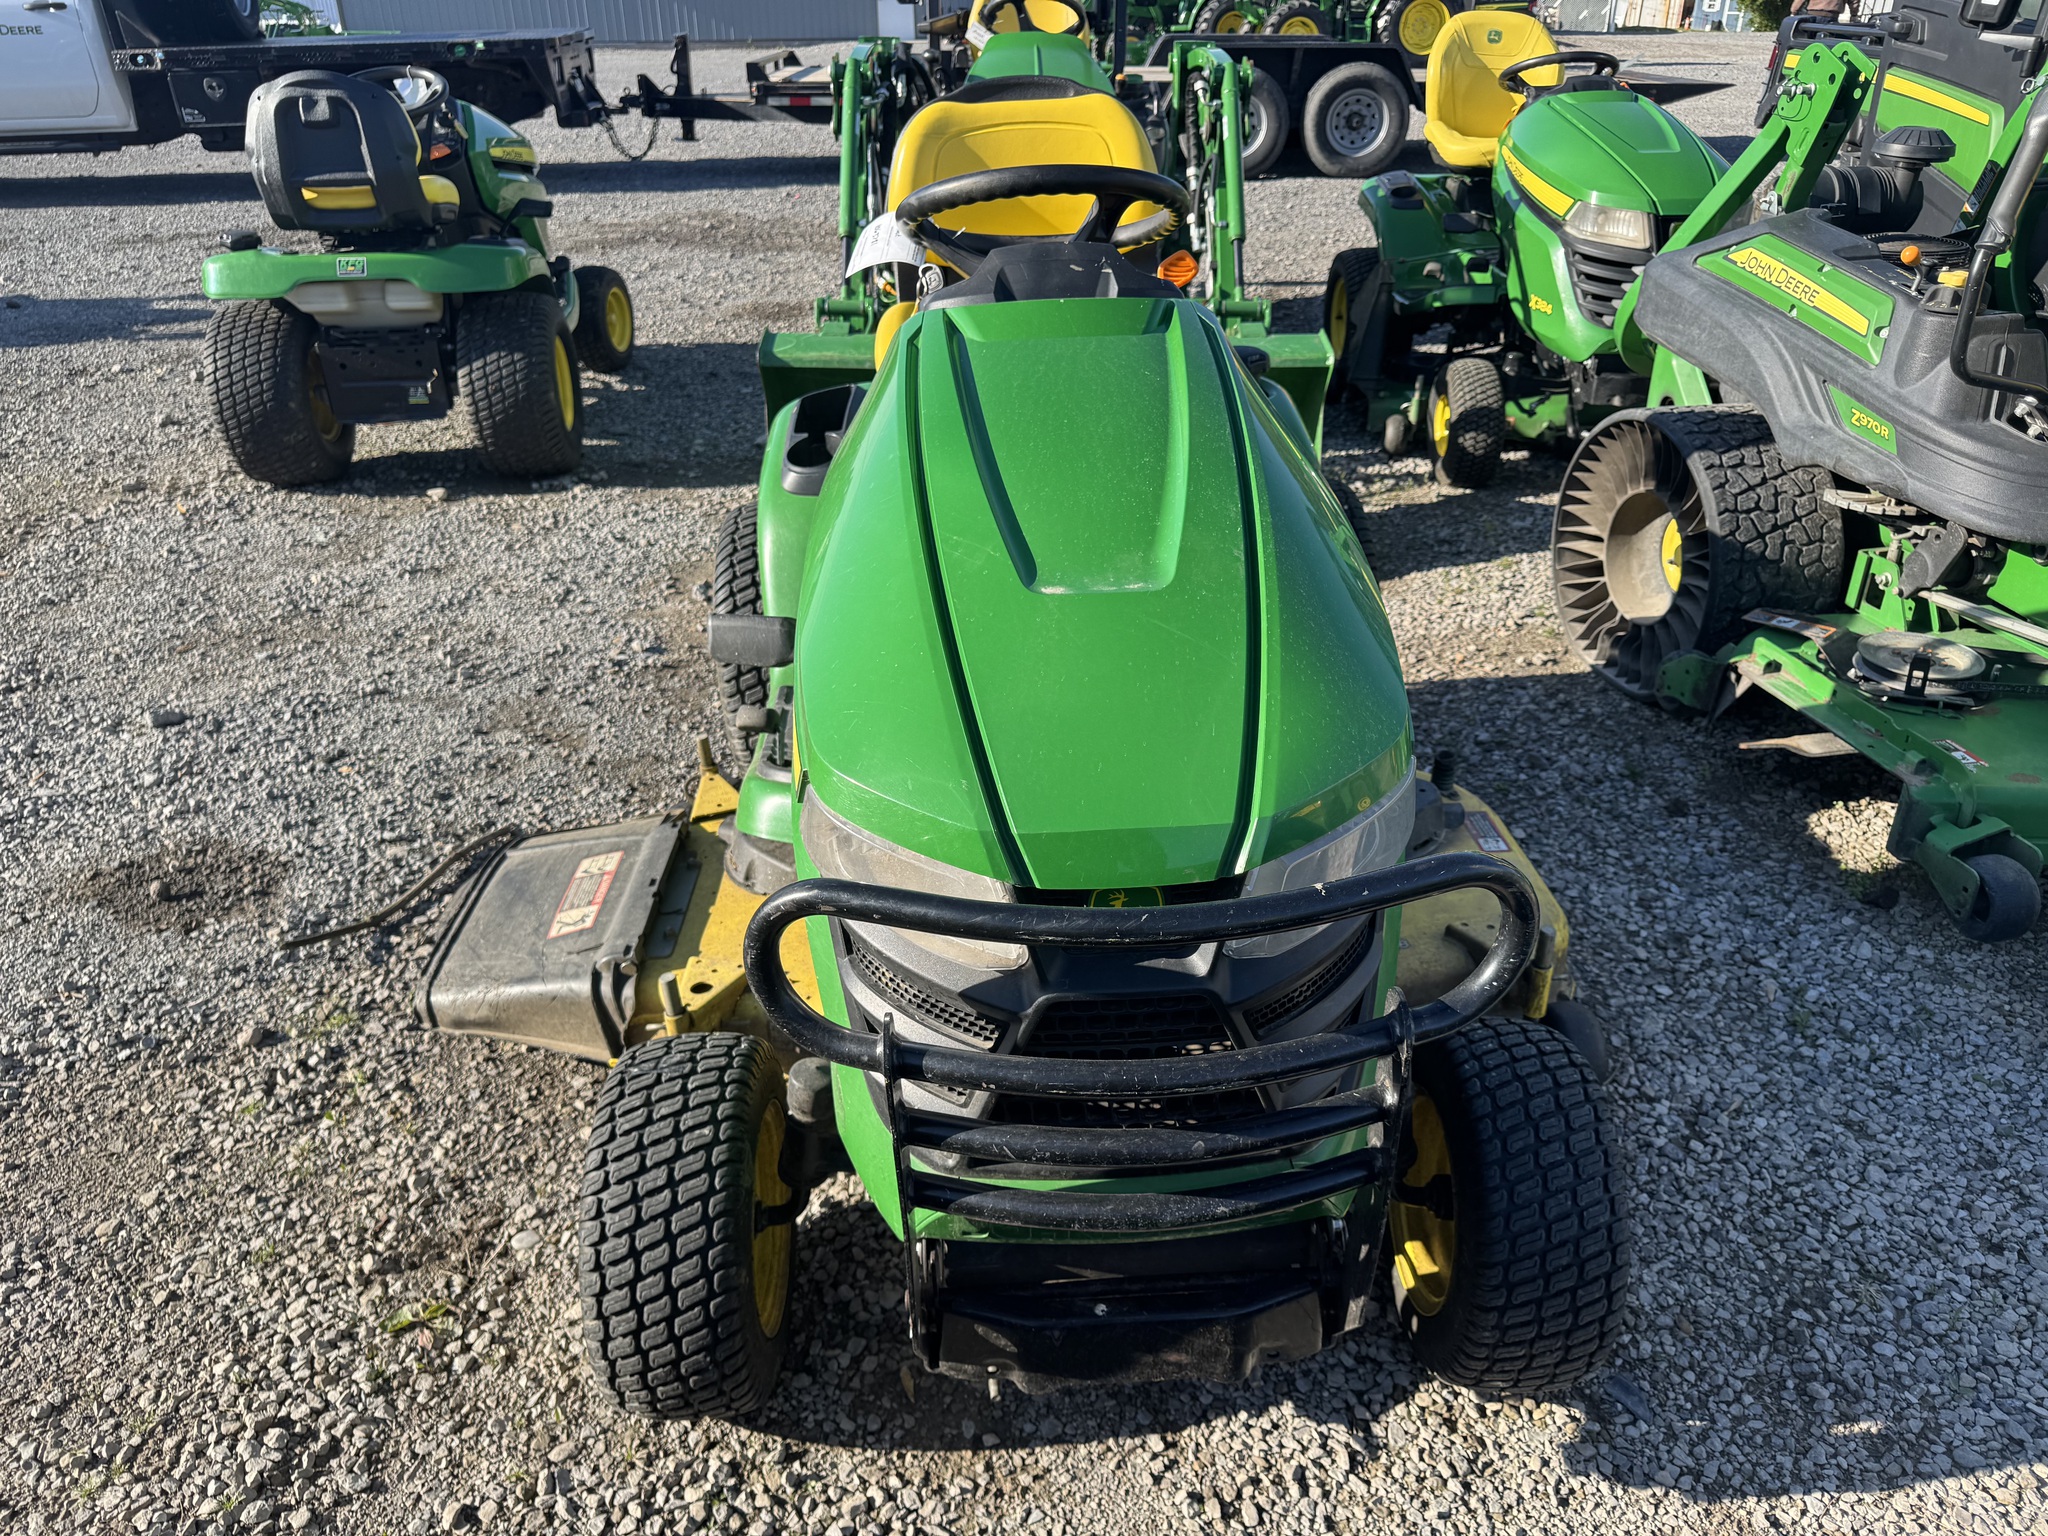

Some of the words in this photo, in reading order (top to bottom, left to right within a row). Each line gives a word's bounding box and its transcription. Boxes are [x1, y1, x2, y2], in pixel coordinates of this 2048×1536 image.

[0, 24, 44, 36] DEERE
[1740, 251, 1777, 279] JOHN
[1775, 267, 1820, 304] DEERE
[1850, 407, 1890, 441] Z970R
